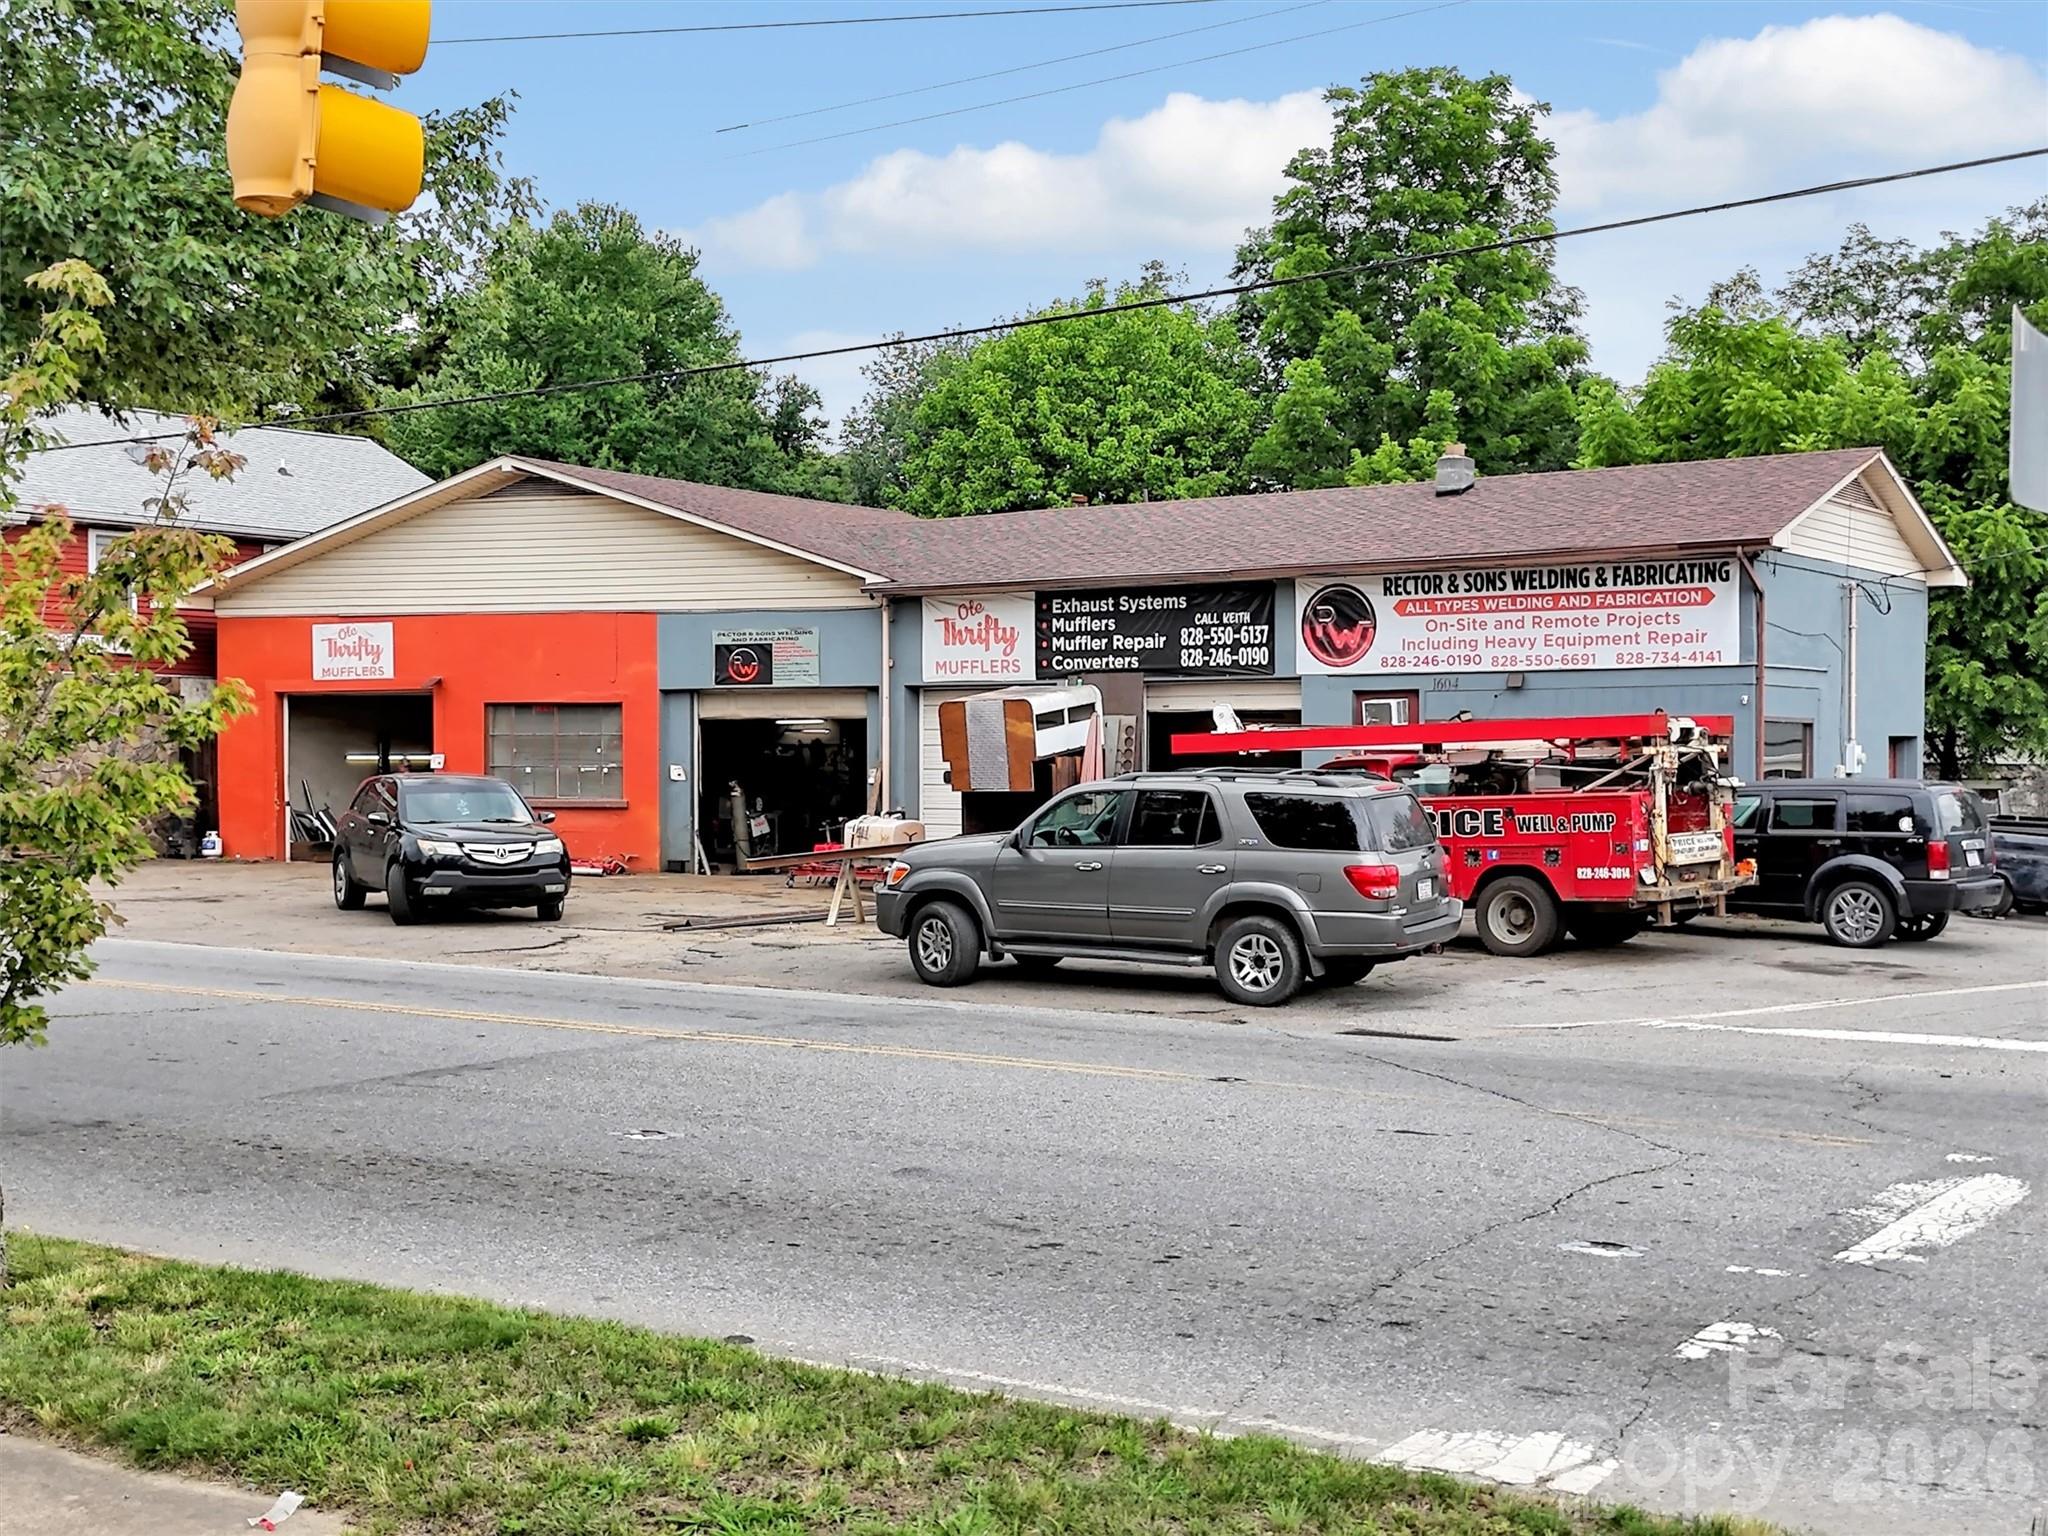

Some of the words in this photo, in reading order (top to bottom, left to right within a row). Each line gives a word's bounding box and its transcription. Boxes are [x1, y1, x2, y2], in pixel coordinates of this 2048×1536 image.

[1383, 574, 1444, 597] RECTOR
[1447, 573, 1459, 593] &
[1463, 571, 1507, 593] SONS
[1510, 566, 1590, 592] WELDING
[1595, 566, 1608, 588] &
[1612, 561, 1730, 587] FABRICATING
[1051, 597, 1115, 614] Exhaust
[1119, 595, 1187, 613] Systems
[1405, 601, 1432, 614] ALL
[1435, 599, 1480, 613] TYPES
[1483, 596, 1553, 612] WELDING
[1558, 593, 1592, 608] AND
[1596, 590, 1702, 607] FABRICATION
[1051, 616, 1116, 633] Mufflers
[1194, 612, 1220, 625] CALL
[1222, 611, 1251, 624] KEITH
[1425, 617, 1488, 633] On-Site
[1493, 615, 1525, 630] and
[1531, 614, 1600, 630] Remote
[1606, 611, 1681, 629] Projects
[934, 614, 1020, 657] Thrifty
[1051, 634, 1108, 652] Muffler
[1112, 632, 1167, 652] Repair
[1180, 625, 1269, 646] 828-550-6137
[1402, 636, 1479, 652] Including
[1484, 635, 1537, 651] Heavy
[1543, 631, 1641, 650] Equipment
[1647, 629, 1708, 647] Repair
[320, 635, 384, 665] Thrifty
[1180, 646, 1269, 667] 828-246-0190
[1380, 653, 1482, 669] 828-246-0190
[1490, 652, 1596, 668] 828-550-6691
[1615, 650, 1722, 665] 828-734-4141
[321, 665, 385, 678] MUFFLERS
[935, 659, 1021, 675] MUFFLERS
[1051, 654, 1139, 670] Converters
[1432, 677, 1459, 691] 1604
[1515, 814, 1554, 833] WELL
[1557, 816, 1570, 833] &
[1570, 812, 1617, 833] PUMP
[1576, 867, 1631, 880] 828-246-3014
